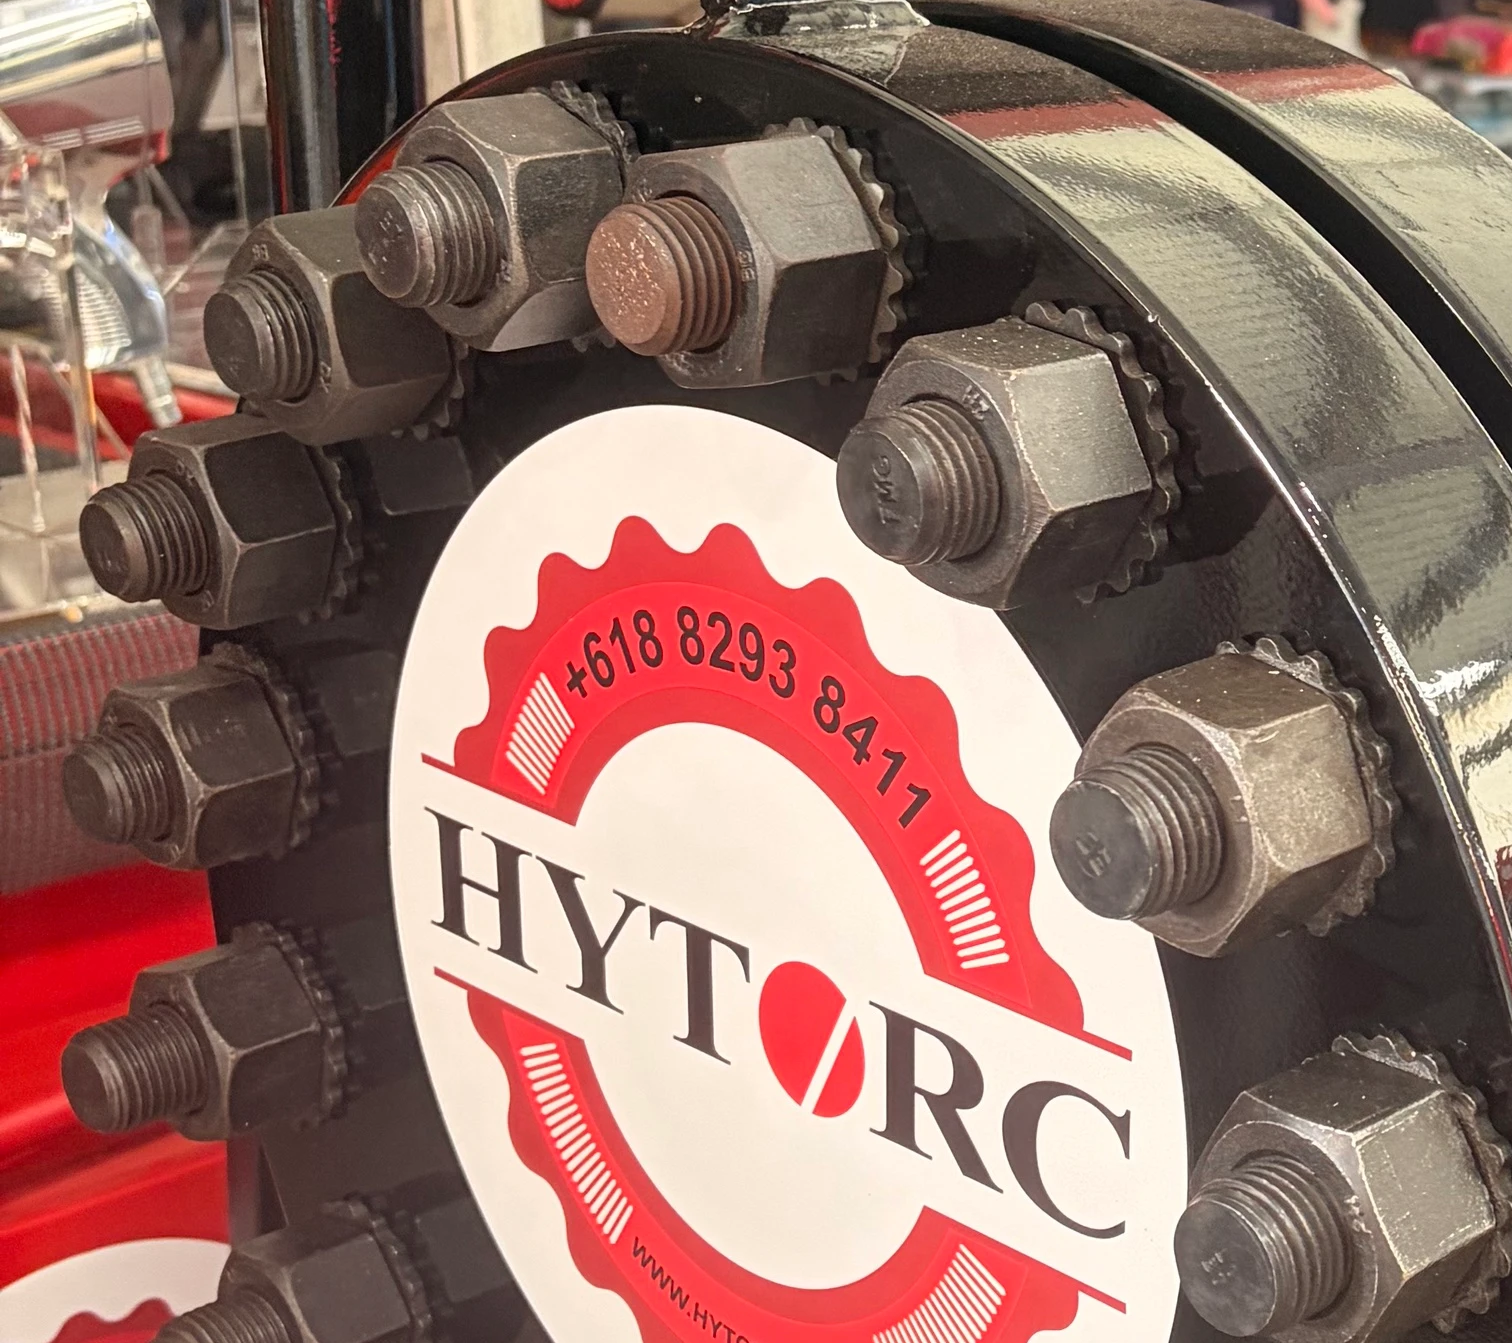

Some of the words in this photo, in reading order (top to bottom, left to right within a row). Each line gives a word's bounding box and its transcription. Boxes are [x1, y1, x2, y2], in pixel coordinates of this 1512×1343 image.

[566, 609, 664, 698] +618
[676, 605, 797, 699] 8293
[813, 675, 932, 829] 8411
[424, 806, 1133, 1240] HYTORC
